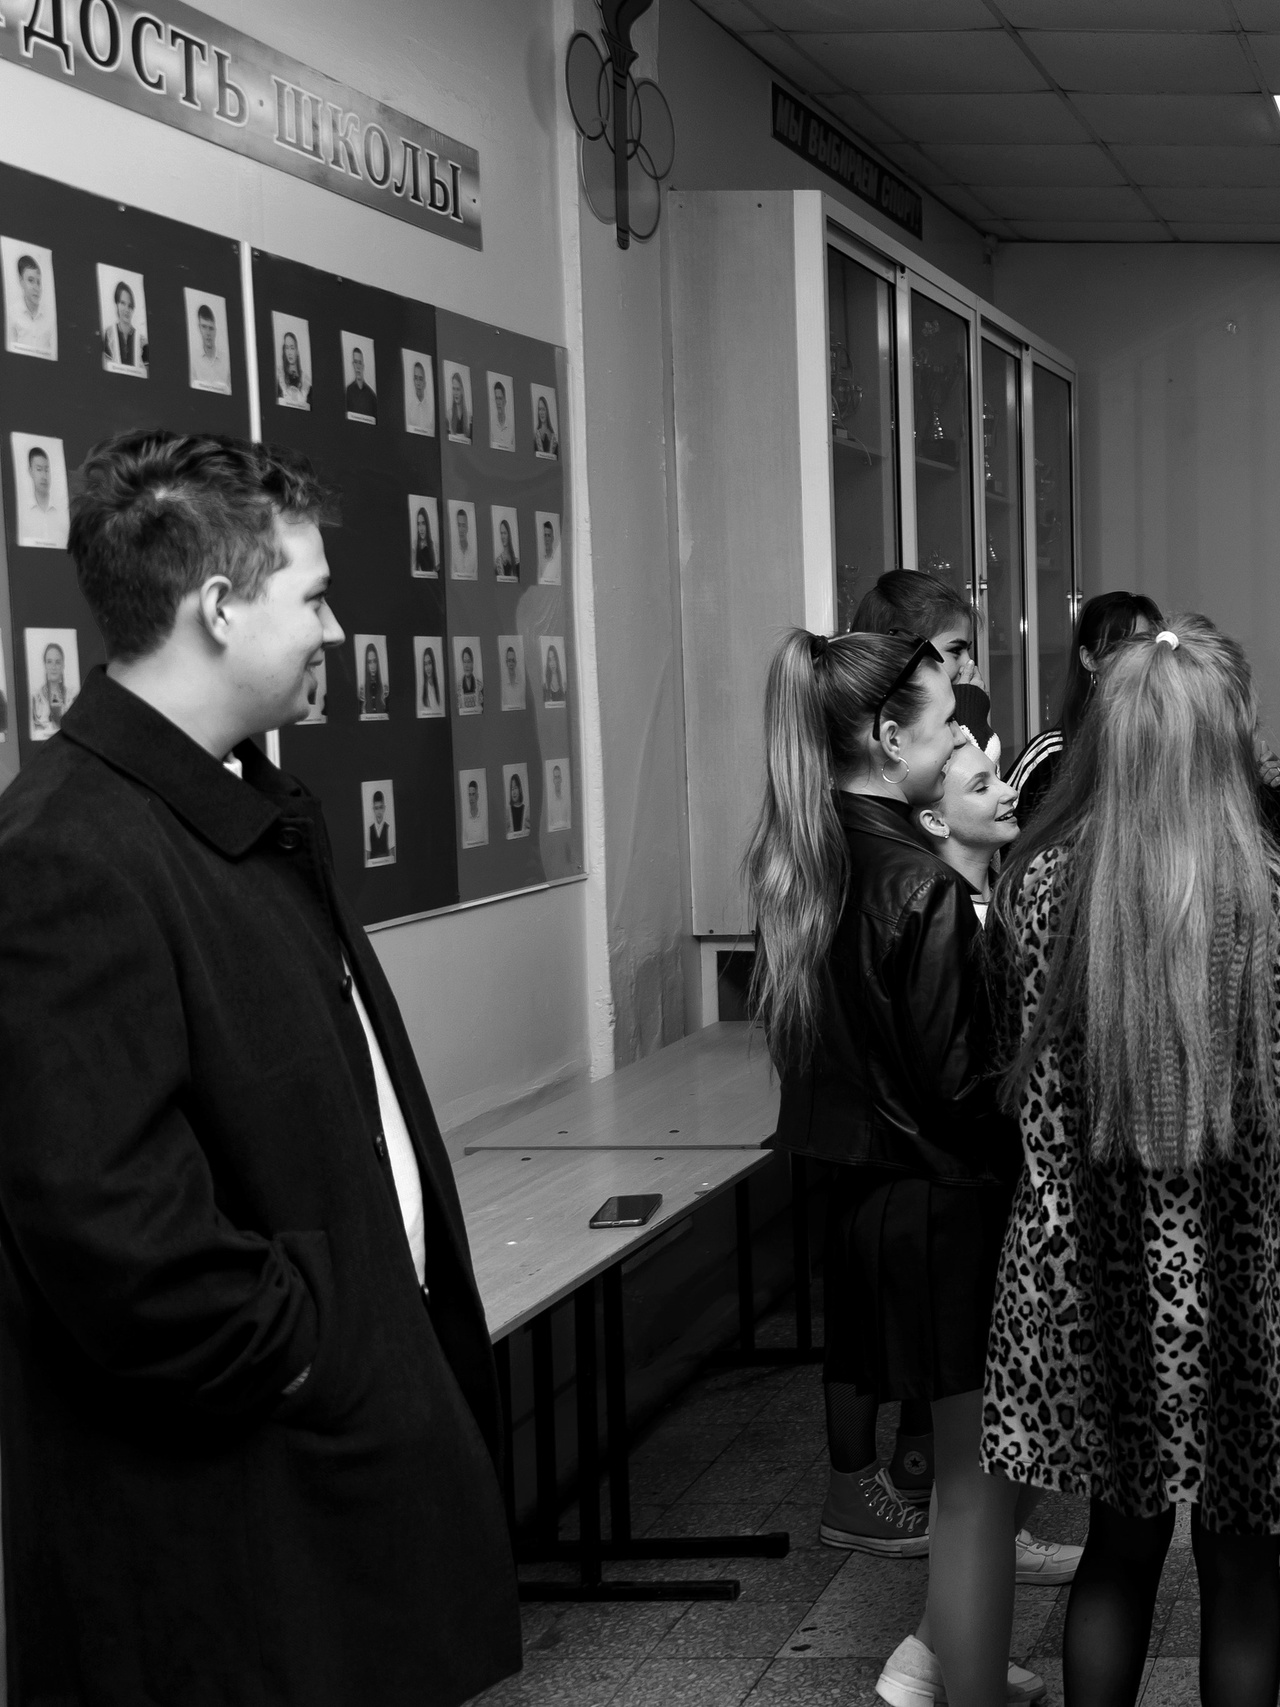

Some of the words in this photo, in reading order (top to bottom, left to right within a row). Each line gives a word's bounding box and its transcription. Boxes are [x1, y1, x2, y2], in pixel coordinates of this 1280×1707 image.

[0, 0, 249, 127] ДОСТЬ
[271, 75, 464, 223] ШКОЛЫ
[776, 92, 804, 147] МЫ
[808, 117, 880, 201] ВЫБИРАЕМ
